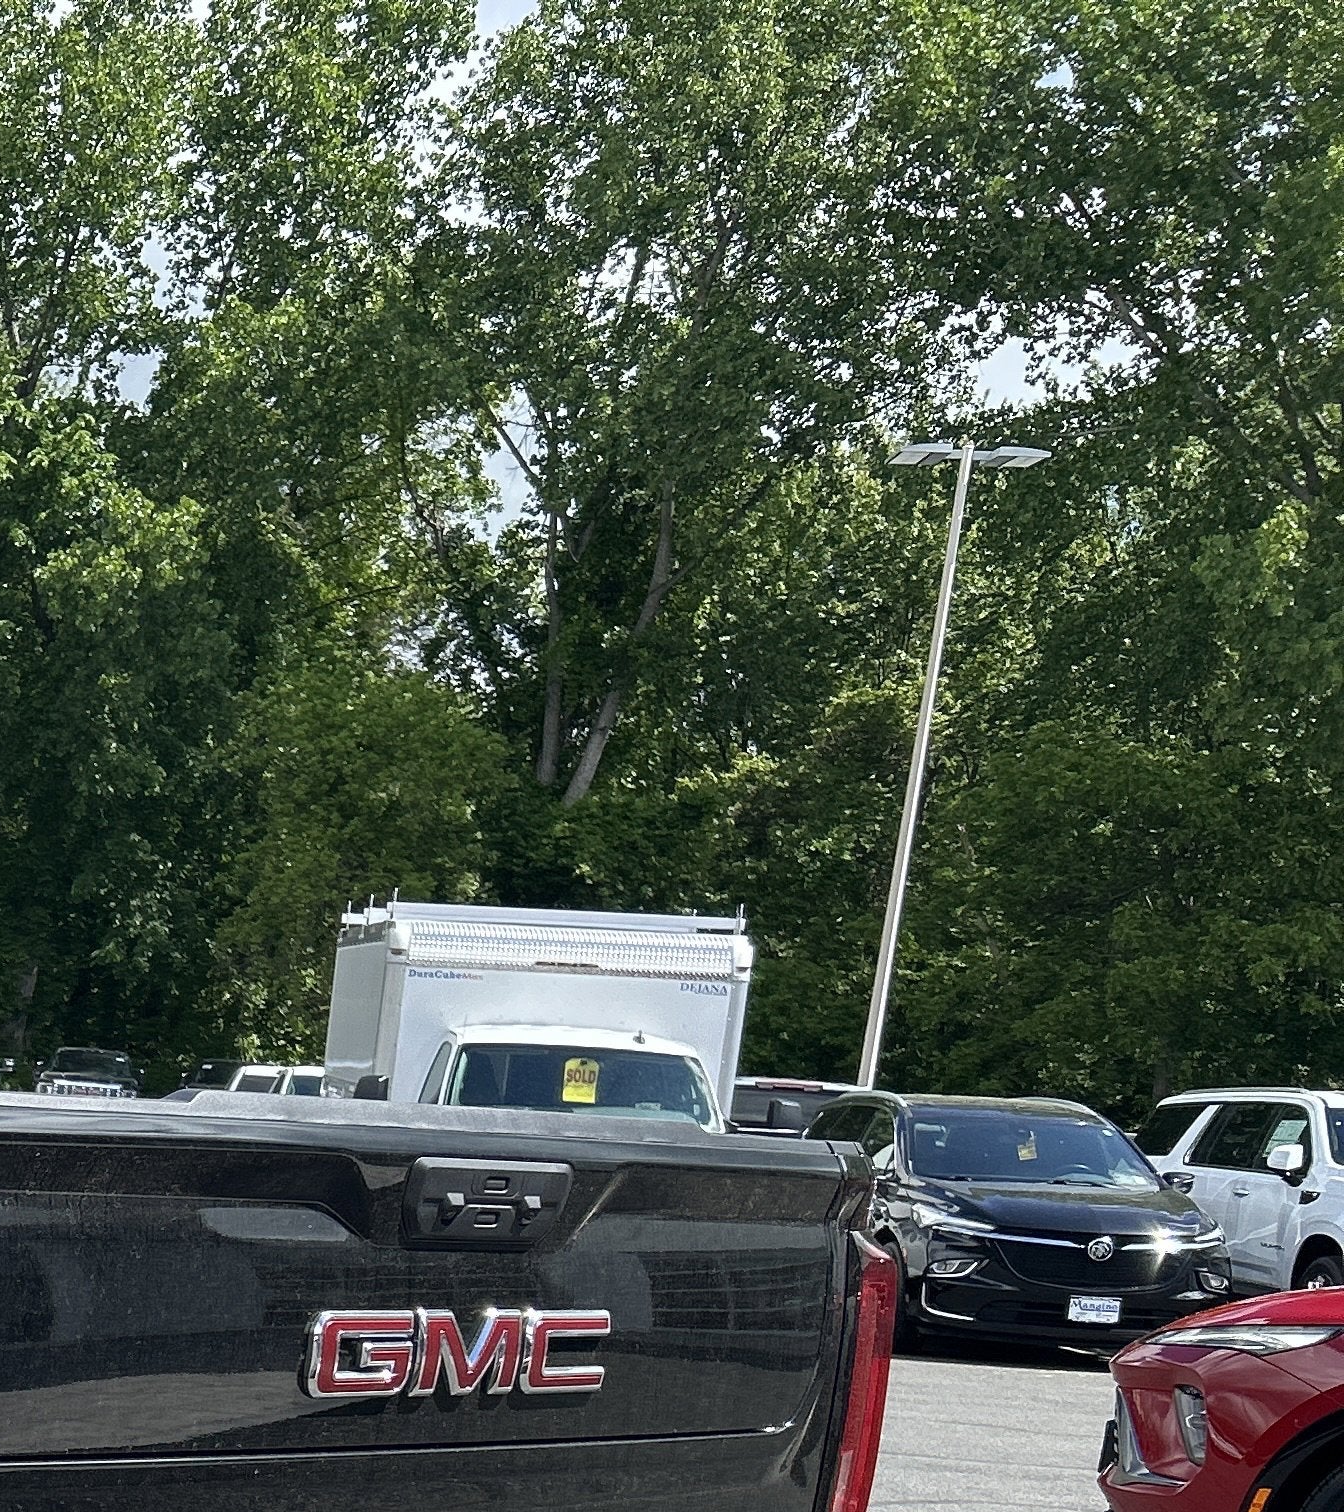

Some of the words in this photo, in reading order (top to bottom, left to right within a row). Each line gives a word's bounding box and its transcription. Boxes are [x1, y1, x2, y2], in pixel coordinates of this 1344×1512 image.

[566, 1068, 597, 1084] SOLD
[1071, 1299, 1119, 1312] Mangino
[307, 1307, 612, 1399] GMC
